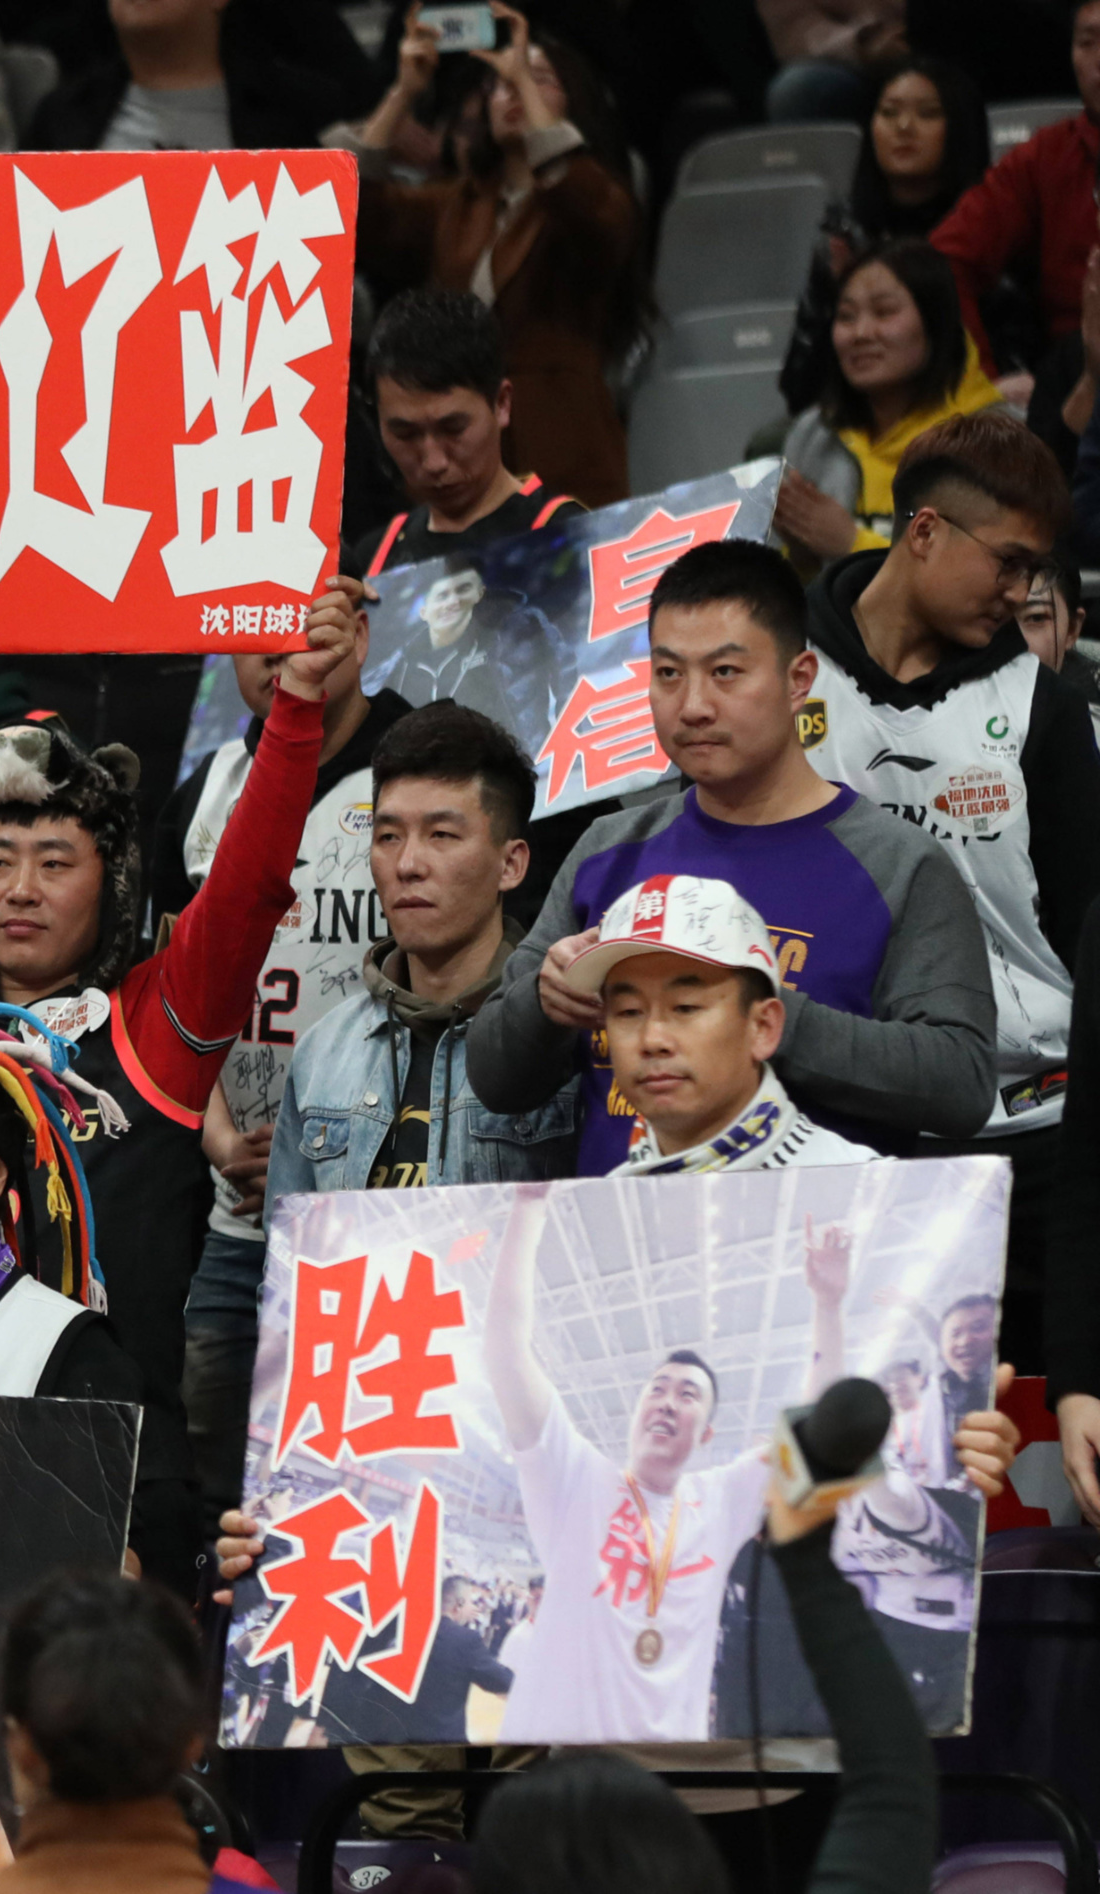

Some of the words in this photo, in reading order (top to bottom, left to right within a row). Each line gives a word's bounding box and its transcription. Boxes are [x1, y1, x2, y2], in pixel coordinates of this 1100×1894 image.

[797, 712, 826, 745] ps
[308, 888, 390, 945] ING
[248, 1249, 466, 1705] 胜利
[358, 1870, 384, 1888] 36
